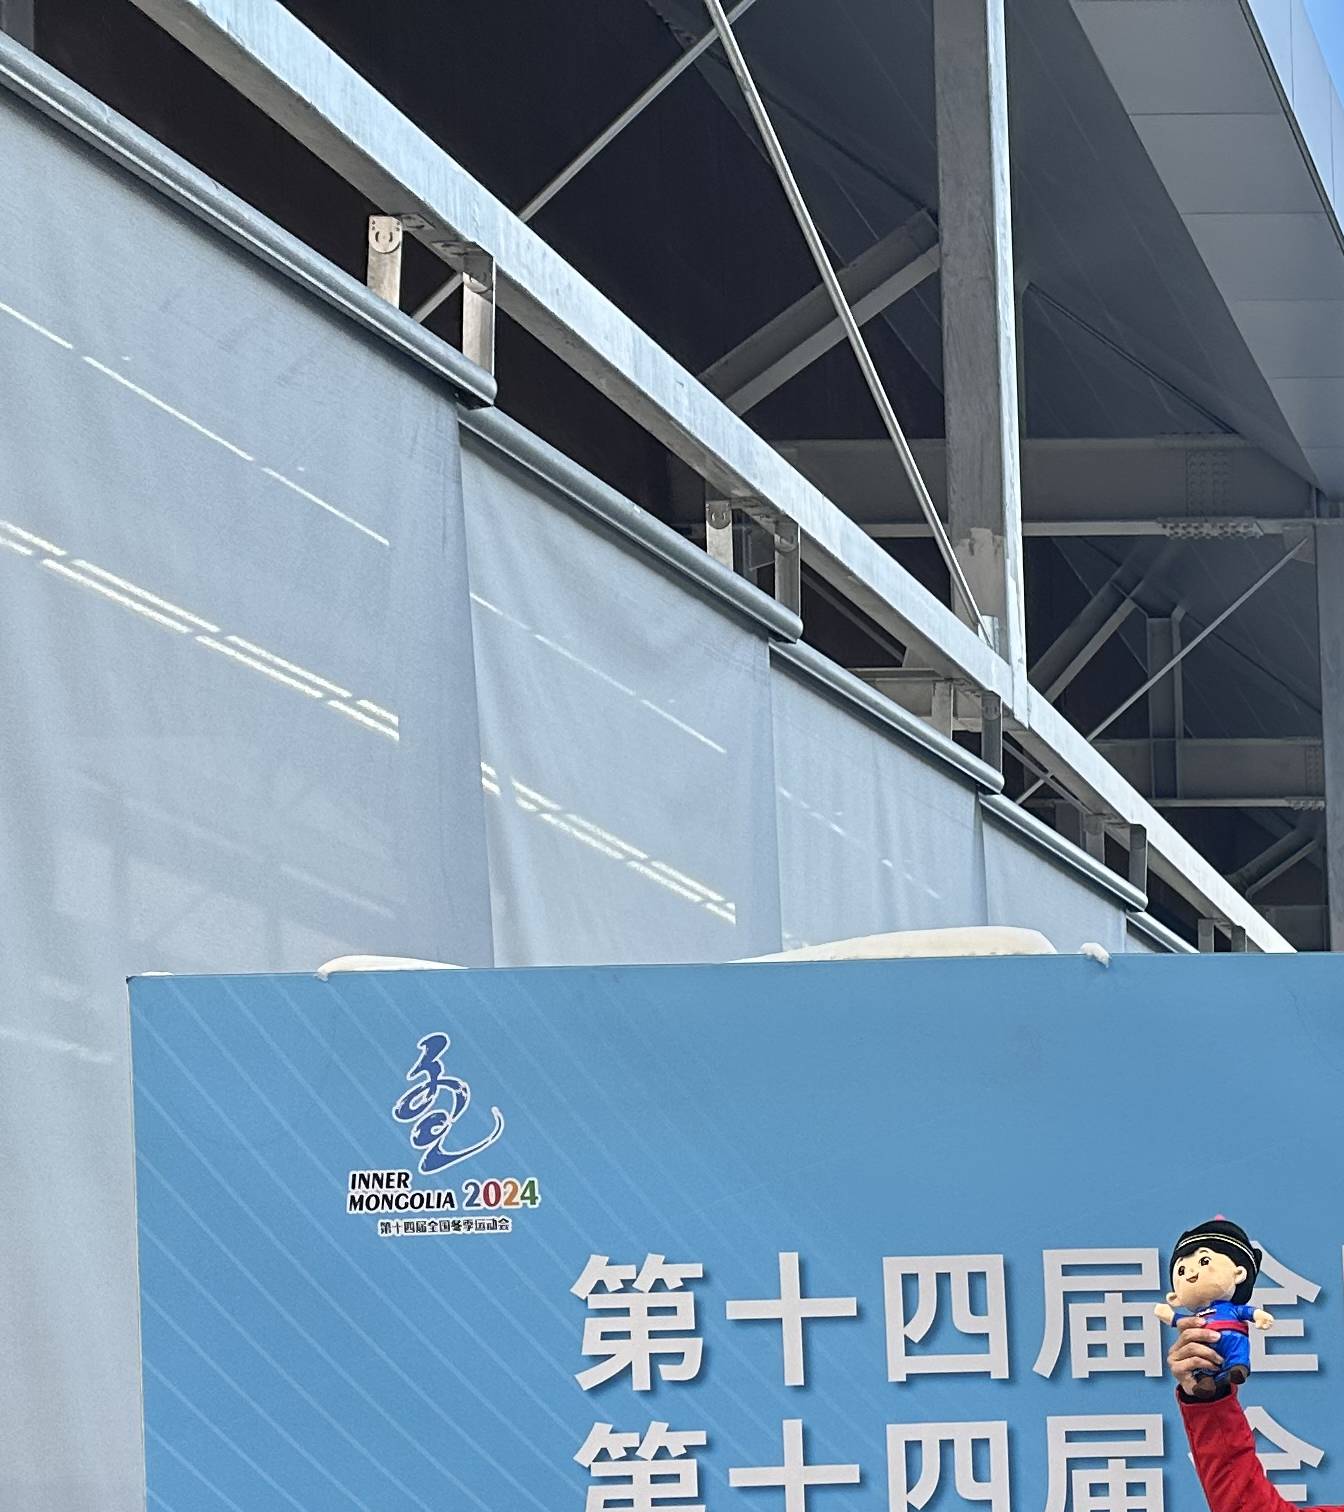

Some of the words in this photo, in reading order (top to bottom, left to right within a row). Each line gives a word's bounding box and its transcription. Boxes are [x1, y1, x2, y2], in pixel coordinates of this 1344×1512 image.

[350, 1171, 411, 1190] INNER
[348, 1190, 456, 1211] MONGOLIA
[463, 1179, 539, 1208] 2024
